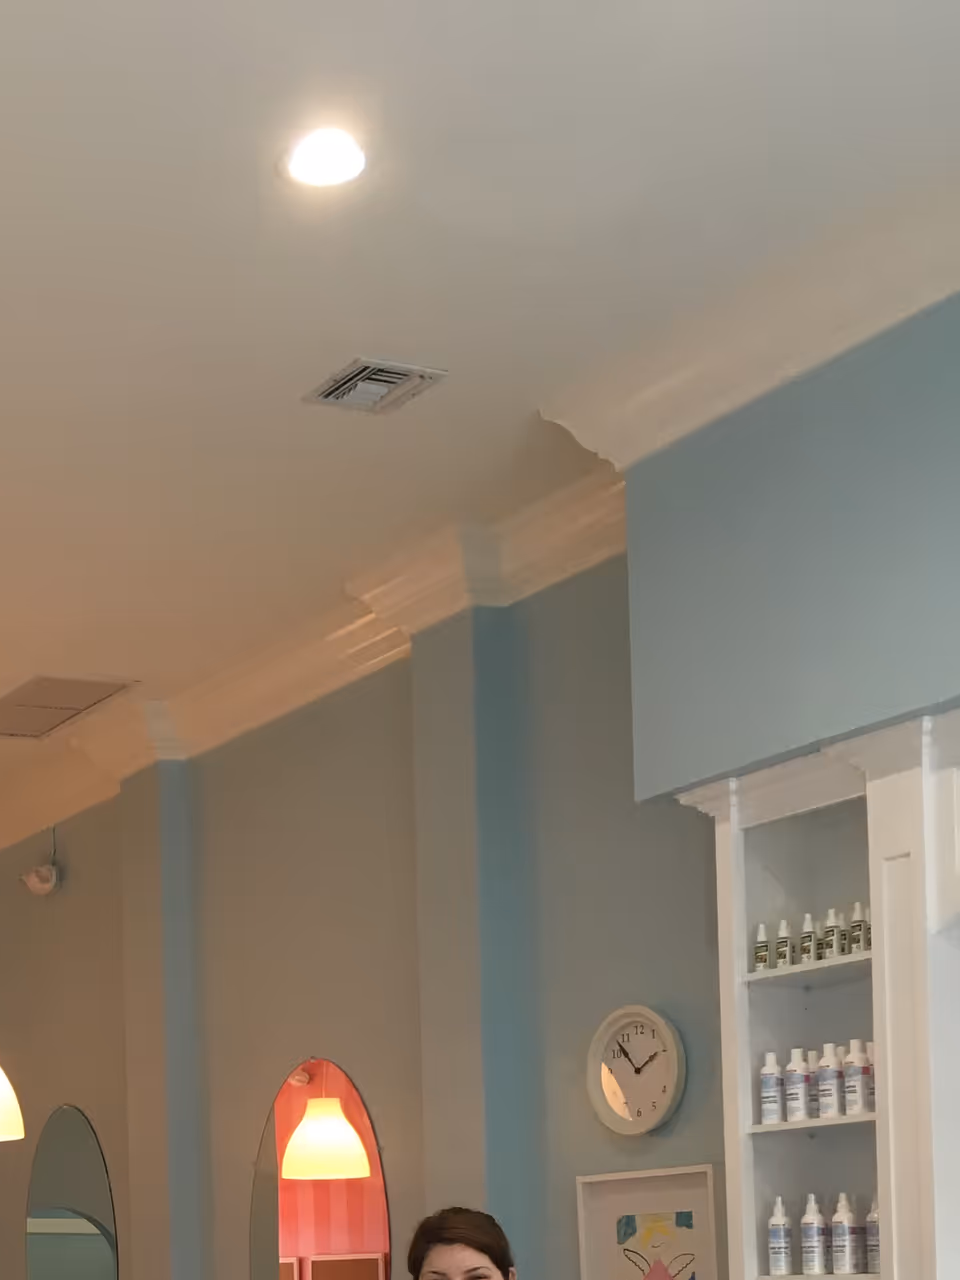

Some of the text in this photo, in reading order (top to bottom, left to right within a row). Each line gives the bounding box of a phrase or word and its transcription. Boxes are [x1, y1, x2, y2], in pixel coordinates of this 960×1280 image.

[633, 1024, 645, 1035] 12
[651, 1029, 656, 1039] 1
[621, 1033, 630, 1043] 11
[612, 1049, 622, 1058] 10
[651, 1101, 657, 1111] 5
[636, 1108, 642, 1117] 6
